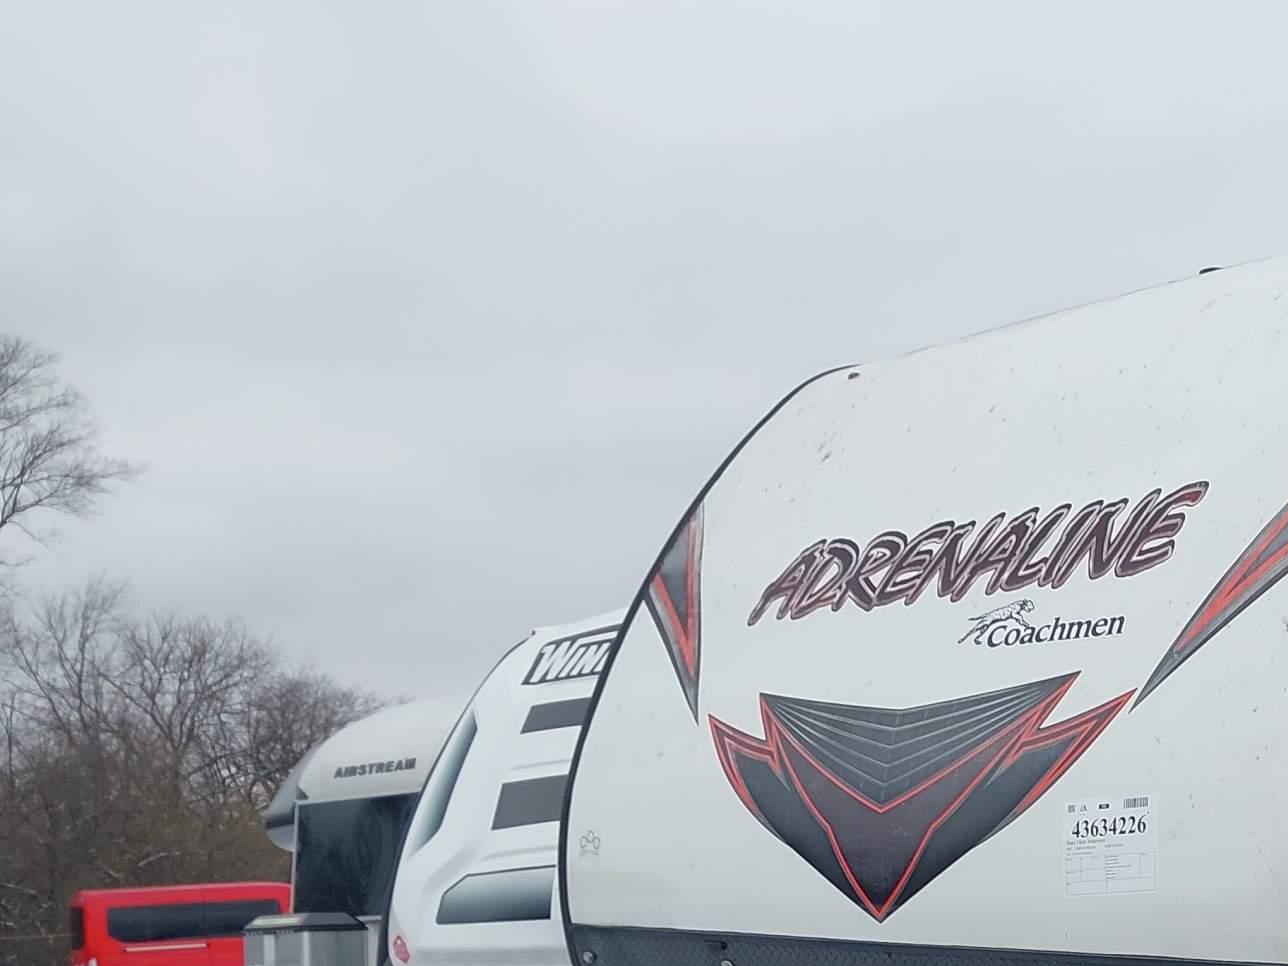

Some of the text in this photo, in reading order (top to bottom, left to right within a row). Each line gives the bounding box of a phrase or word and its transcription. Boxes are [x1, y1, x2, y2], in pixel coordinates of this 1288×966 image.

[747, 481, 1210, 626] ADRENALINE
[987, 616, 1125, 647] Coachmen
[334, 757, 416, 779] AIRSTREAM
[1071, 814, 1147, 838] 43634226
